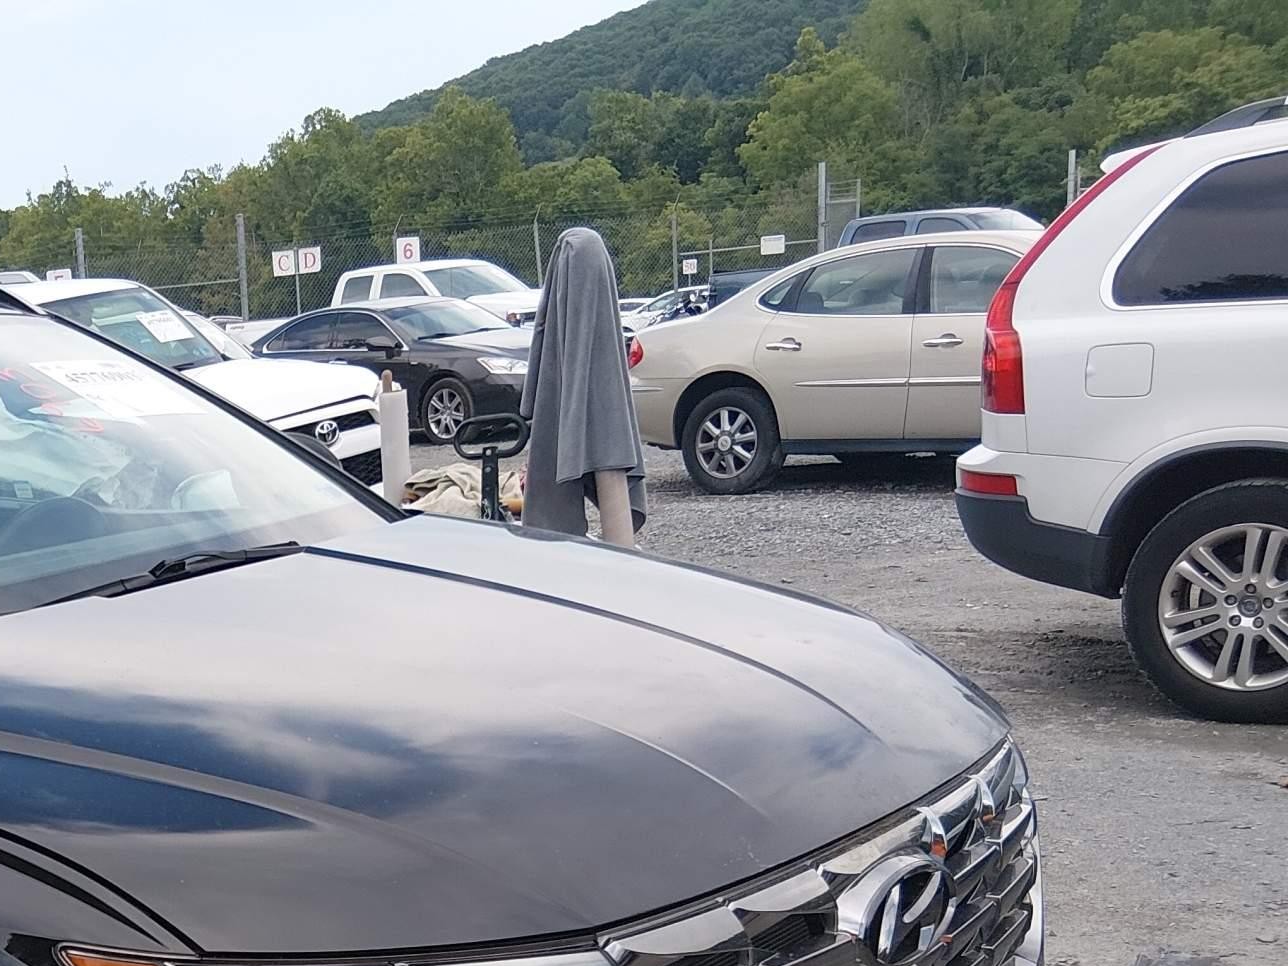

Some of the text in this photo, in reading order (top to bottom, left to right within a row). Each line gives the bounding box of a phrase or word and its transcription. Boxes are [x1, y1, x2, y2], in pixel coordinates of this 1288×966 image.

[403, 243, 414, 259] 6
[278, 255, 290, 271] C
[304, 252, 316, 268] D
